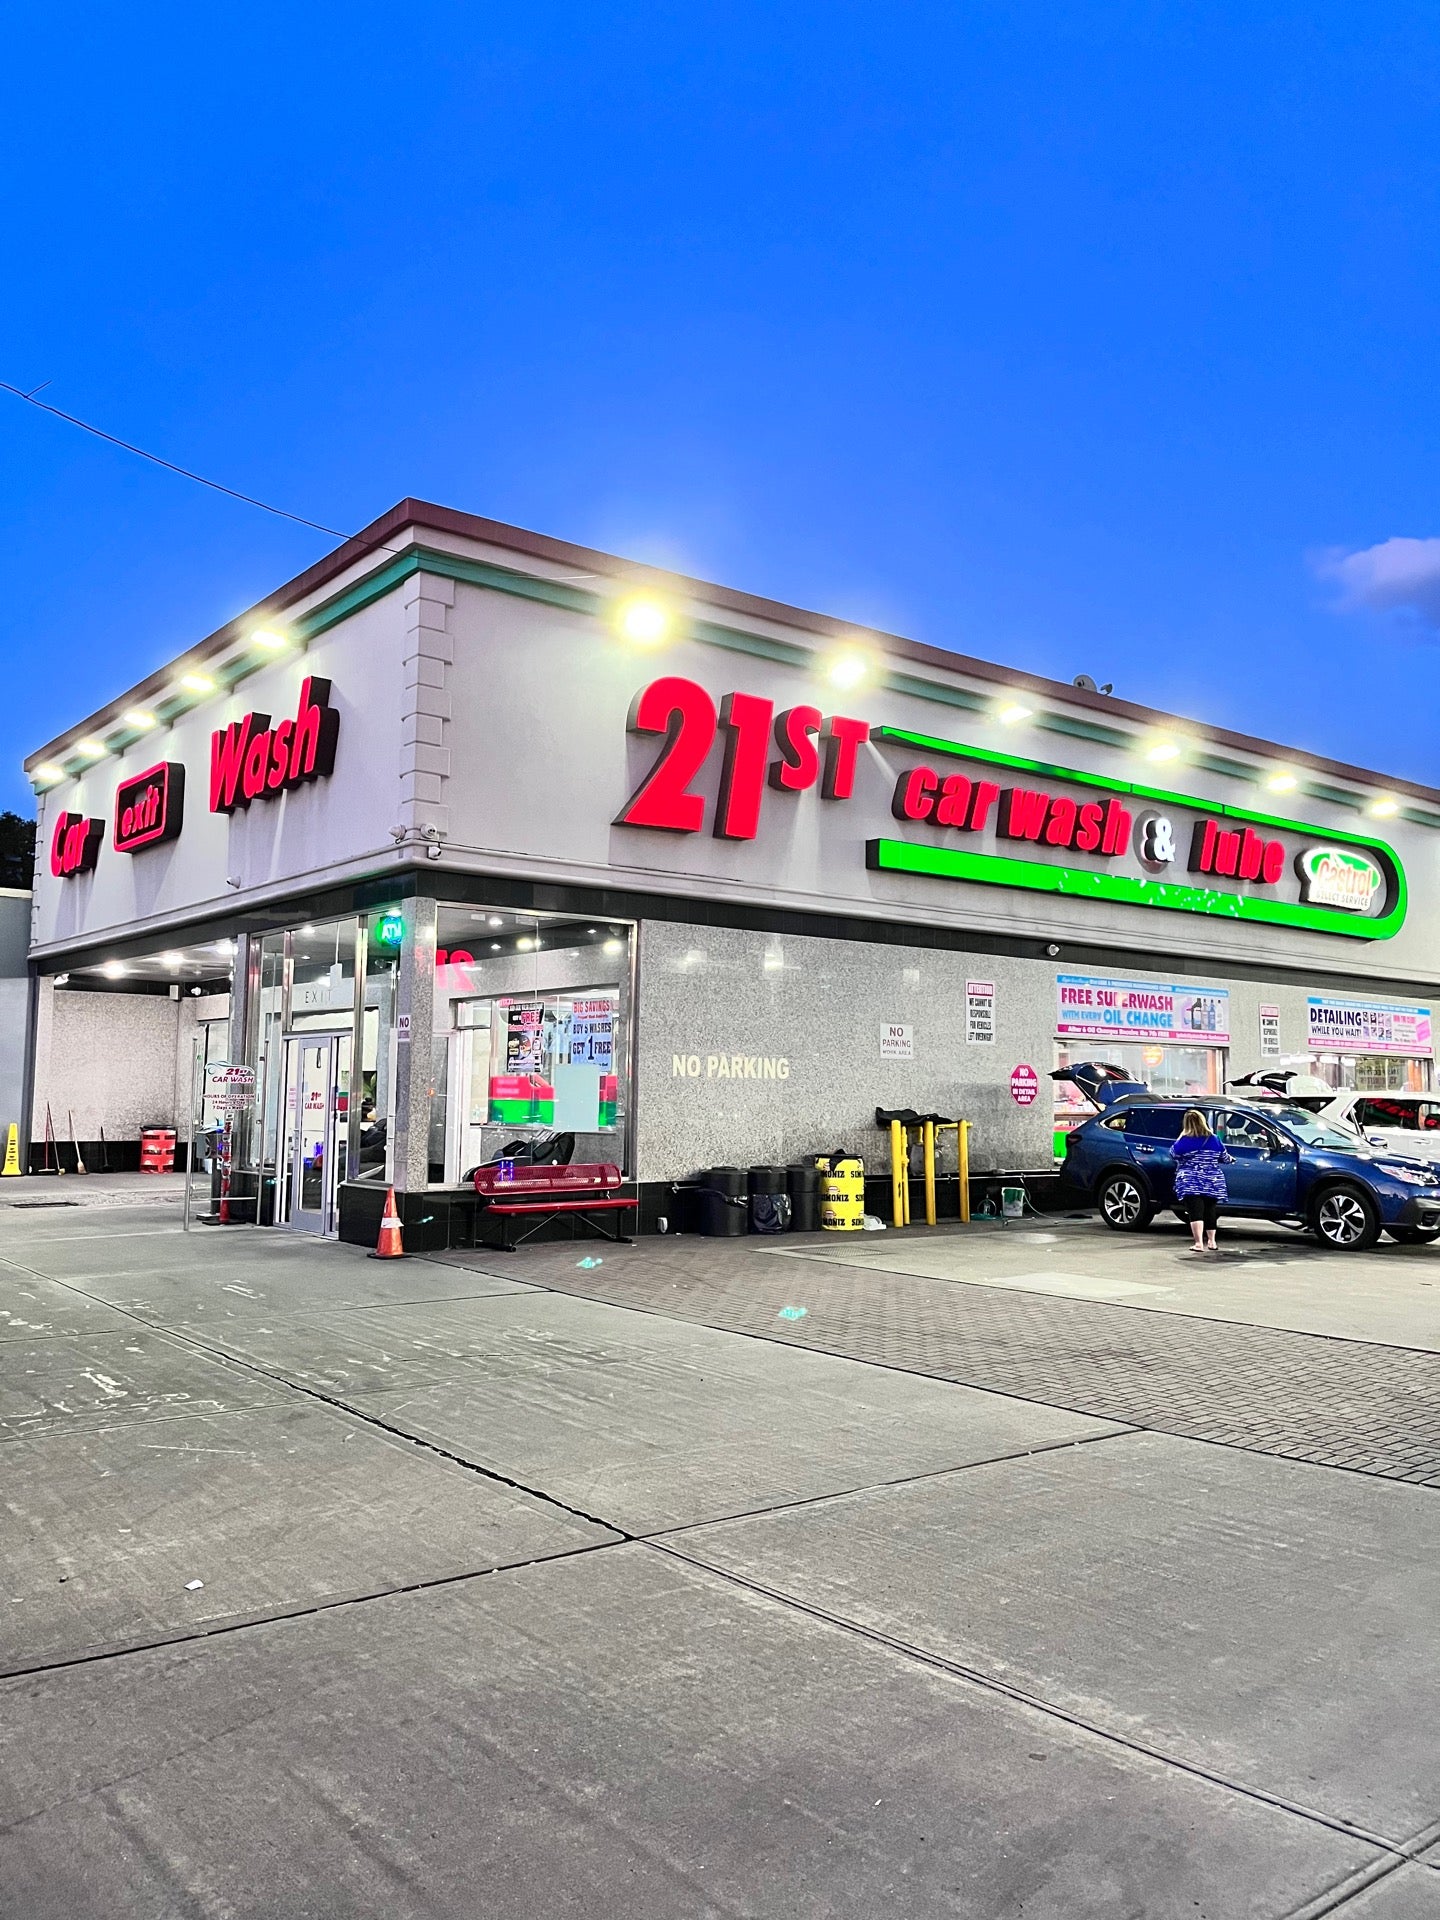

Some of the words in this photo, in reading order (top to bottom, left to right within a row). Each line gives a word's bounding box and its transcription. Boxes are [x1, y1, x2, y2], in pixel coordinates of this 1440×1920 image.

[622, 676, 870, 840] 21ST
[51, 810, 90, 877] Car
[210, 676, 321, 813] Wash
[121, 784, 160, 837] exit
[903, 766, 999, 831] car
[1008, 787, 1132, 856] wash
[1149, 816, 1176, 862] &
[1199, 818, 1286, 884] lube
[1319, 860, 1372, 897] Castrol
[1341, 893, 1369, 907] SERVICE
[305, 988, 332, 1004] EXIT
[1061, 987, 1093, 1006] FREE
[574, 1002, 583, 1014] BIG
[400, 1016, 409, 1028] NO
[521, 1011, 540, 1024] FREE
[1062, 1010, 1080, 1019] WITH
[1081, 1011, 1102, 1020] EVERY
[1103, 1009, 1123, 1025] OIL
[1126, 1010, 1173, 1028] CHANGE
[1310, 1007, 1362, 1026] DETAILING
[573, 1023, 584, 1034] BUY
[590, 1022, 612, 1034] WASHES
[889, 1026, 904, 1037] NO
[1311, 1026, 1330, 1035] WHILE
[1331, 1027, 1344, 1036] YOU
[1345, 1028, 1361, 1037] WAIT!
[572, 1042, 586, 1055] GET
[587, 1035, 595, 1061] 1
[595, 1041, 611, 1055] FREE
[882, 1038, 911, 1048] PARKING
[672, 1054, 701, 1078] NO
[707, 1055, 790, 1080] PARKING
[1019, 1067, 1029, 1077] NO
[1011, 1077, 1037, 1087] PARKING
[1018, 1088, 1036, 1096] DETAIL
[304, 1102, 313, 1110] CAR
[821, 1170, 846, 1178] MONIZ
